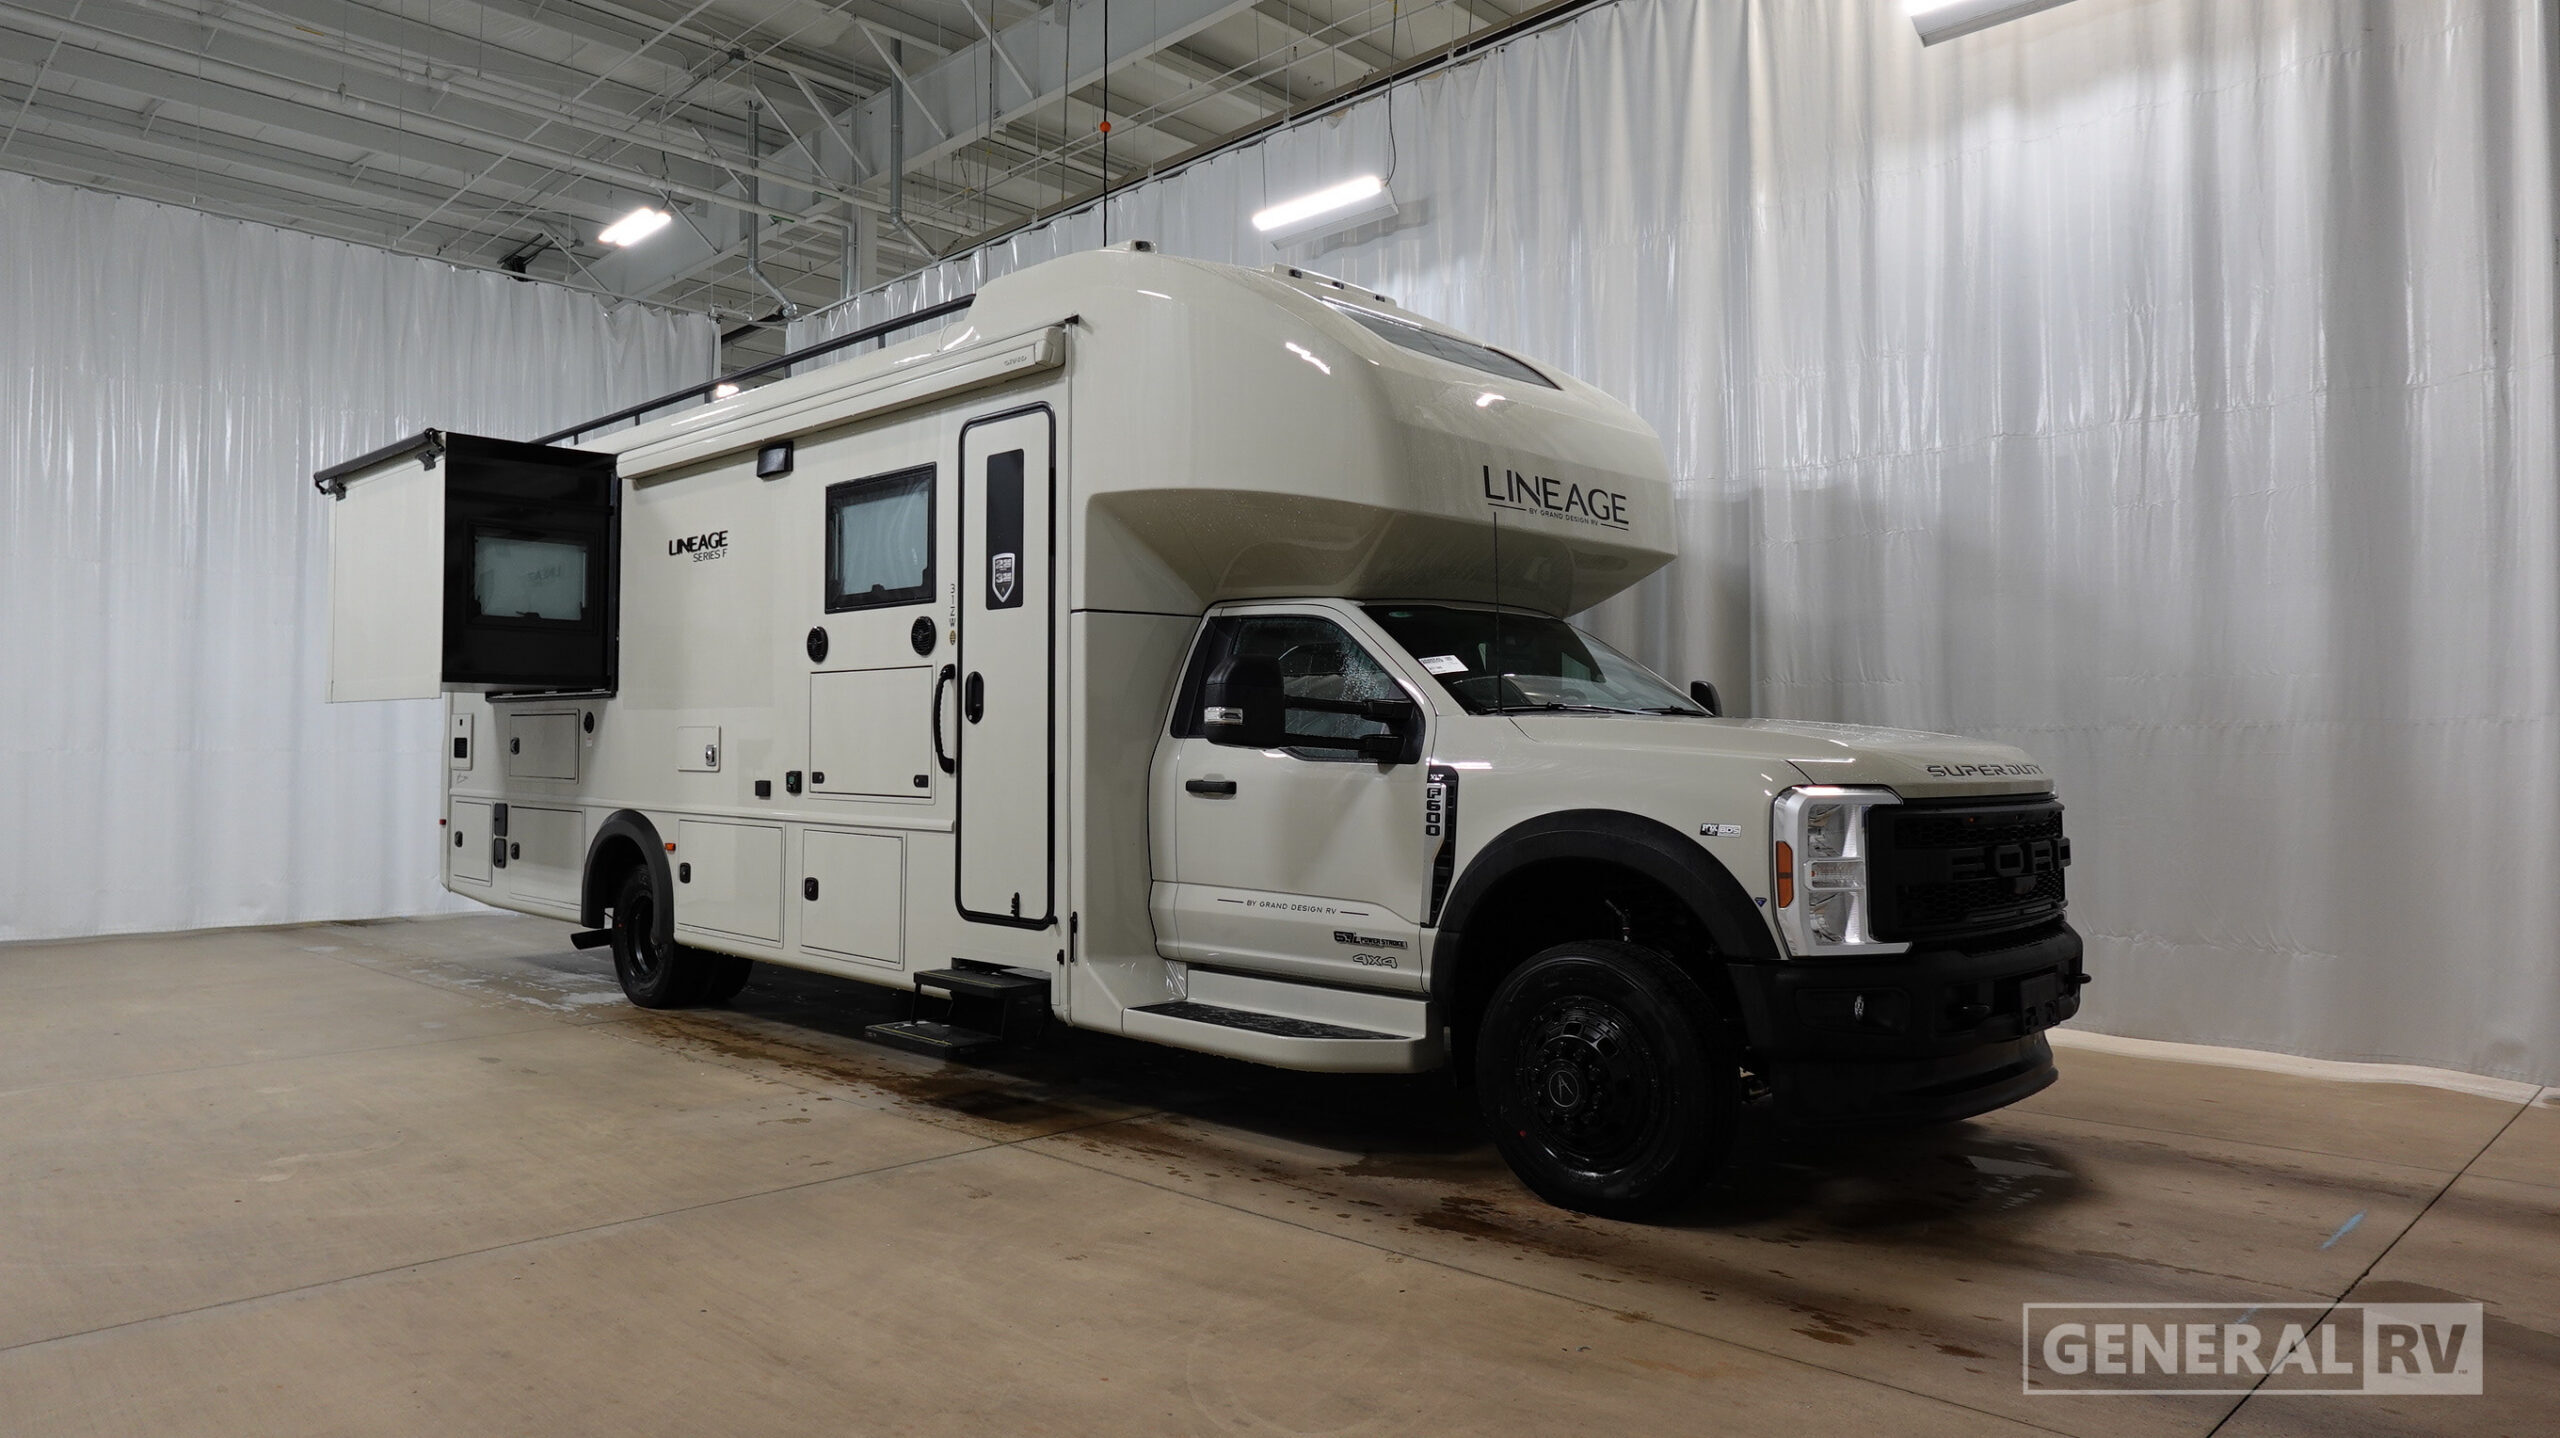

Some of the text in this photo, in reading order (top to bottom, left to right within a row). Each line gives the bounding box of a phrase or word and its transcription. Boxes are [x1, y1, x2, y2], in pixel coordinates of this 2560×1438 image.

[1483, 465, 1629, 525] LINEAGE
[1528, 507, 1538, 516] BY
[1540, 509, 1564, 520] GRAND
[1565, 514, 1590, 525] DESIGN
[669, 530, 728, 556] LINEAGE
[693, 548, 728, 562] SERIES F
[1430, 773, 1445, 781] XLT
[1926, 763, 2044, 778] SUPER DUTY
[1426, 787, 1442, 837] F600
[1719, 826, 1740, 835] BDS
[1246, 899, 1337, 915] BY GRAND DESIGN RV
